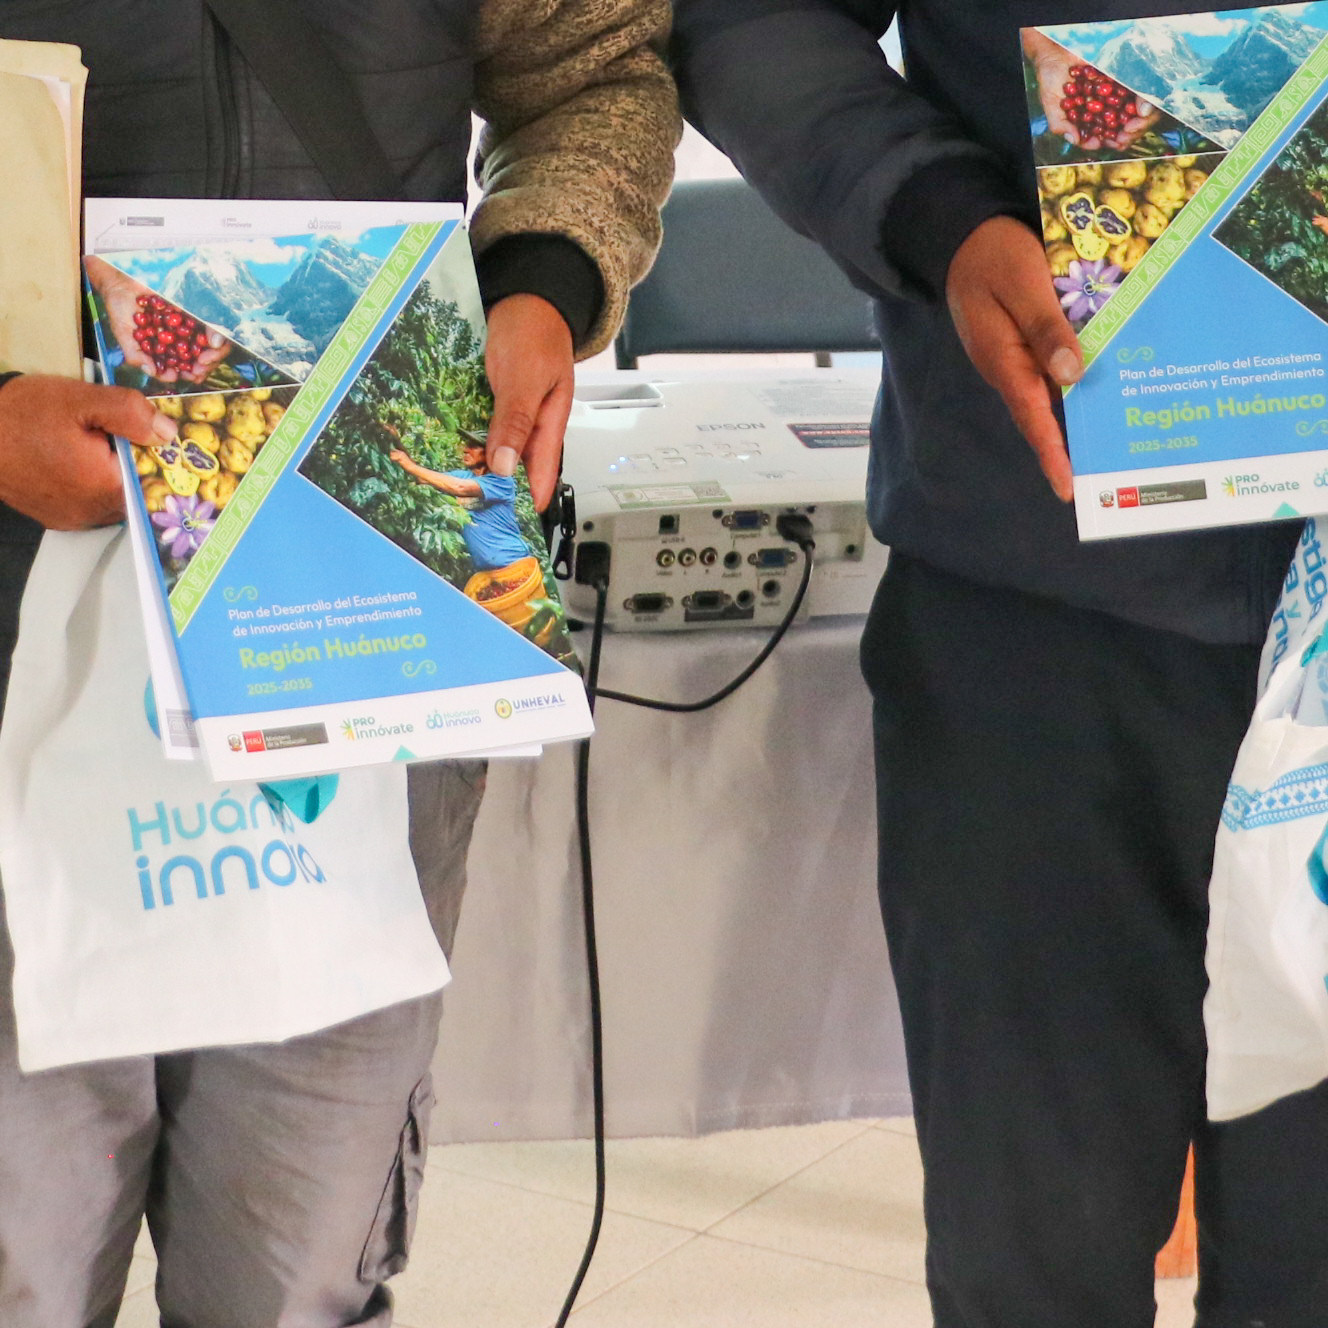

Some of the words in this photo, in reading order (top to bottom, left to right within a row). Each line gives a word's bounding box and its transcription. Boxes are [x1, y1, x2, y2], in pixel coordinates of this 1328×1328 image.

[1120, 369, 1146, 380] Plan
[1149, 367, 1164, 377] de
[1166, 361, 1230, 376] Desarrollo
[1233, 358, 1250, 368] del
[1254, 353, 1321, 367] Ecosistema
[1122, 386, 1137, 396] de
[1140, 378, 1208, 394] Innovación
[1210, 379, 1217, 389] y
[1221, 368, 1324, 386] Emprendimiento
[1125, 401, 1210, 430] Región
[1216, 394, 1326, 417] Huánuco
[697, 422, 766, 431] EPSON
[1129, 436, 1198, 453] 2025-2035
[1236, 474, 1260, 483] PRO
[1237, 481, 1299, 496] innóvate
[228, 610, 253, 620] Plan
[256, 607, 270, 617] de
[272, 600, 331, 616] Desarrollo
[334, 597, 351, 609] del
[354, 591, 416, 606] Ecosistema
[233, 626, 248, 637] de
[251, 619, 313, 634] Innovación
[316, 619, 322, 629] y
[325, 607, 422, 626] Emprendimiento
[240, 642, 320, 671] Región
[324, 633, 427, 659] Huánuco
[247, 678, 312, 695] 2025-2035
[513, 694, 565, 709] UNHEVAL
[353, 717, 375, 727] PRO
[445, 715, 481, 727] innova
[356, 723, 413, 740] innóvate
